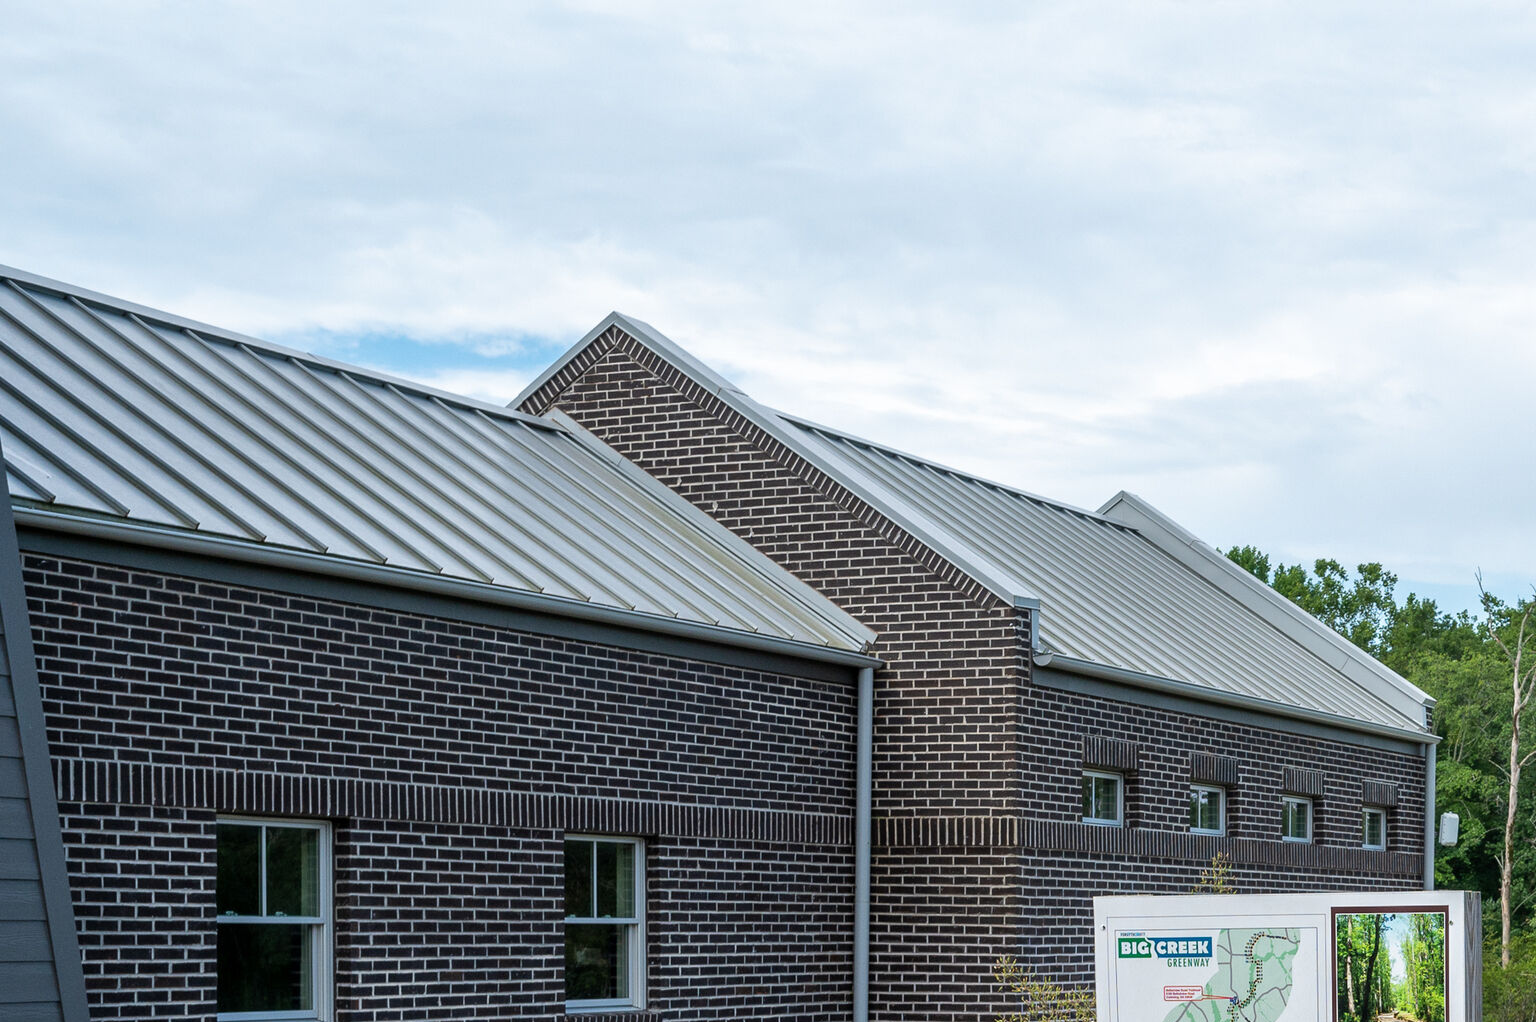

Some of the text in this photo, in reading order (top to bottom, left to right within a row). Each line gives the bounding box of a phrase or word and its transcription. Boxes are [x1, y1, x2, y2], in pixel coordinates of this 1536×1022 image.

[1121, 941, 1208, 954] BIG CREEK
[1167, 959, 1209, 967] GREENWAY
